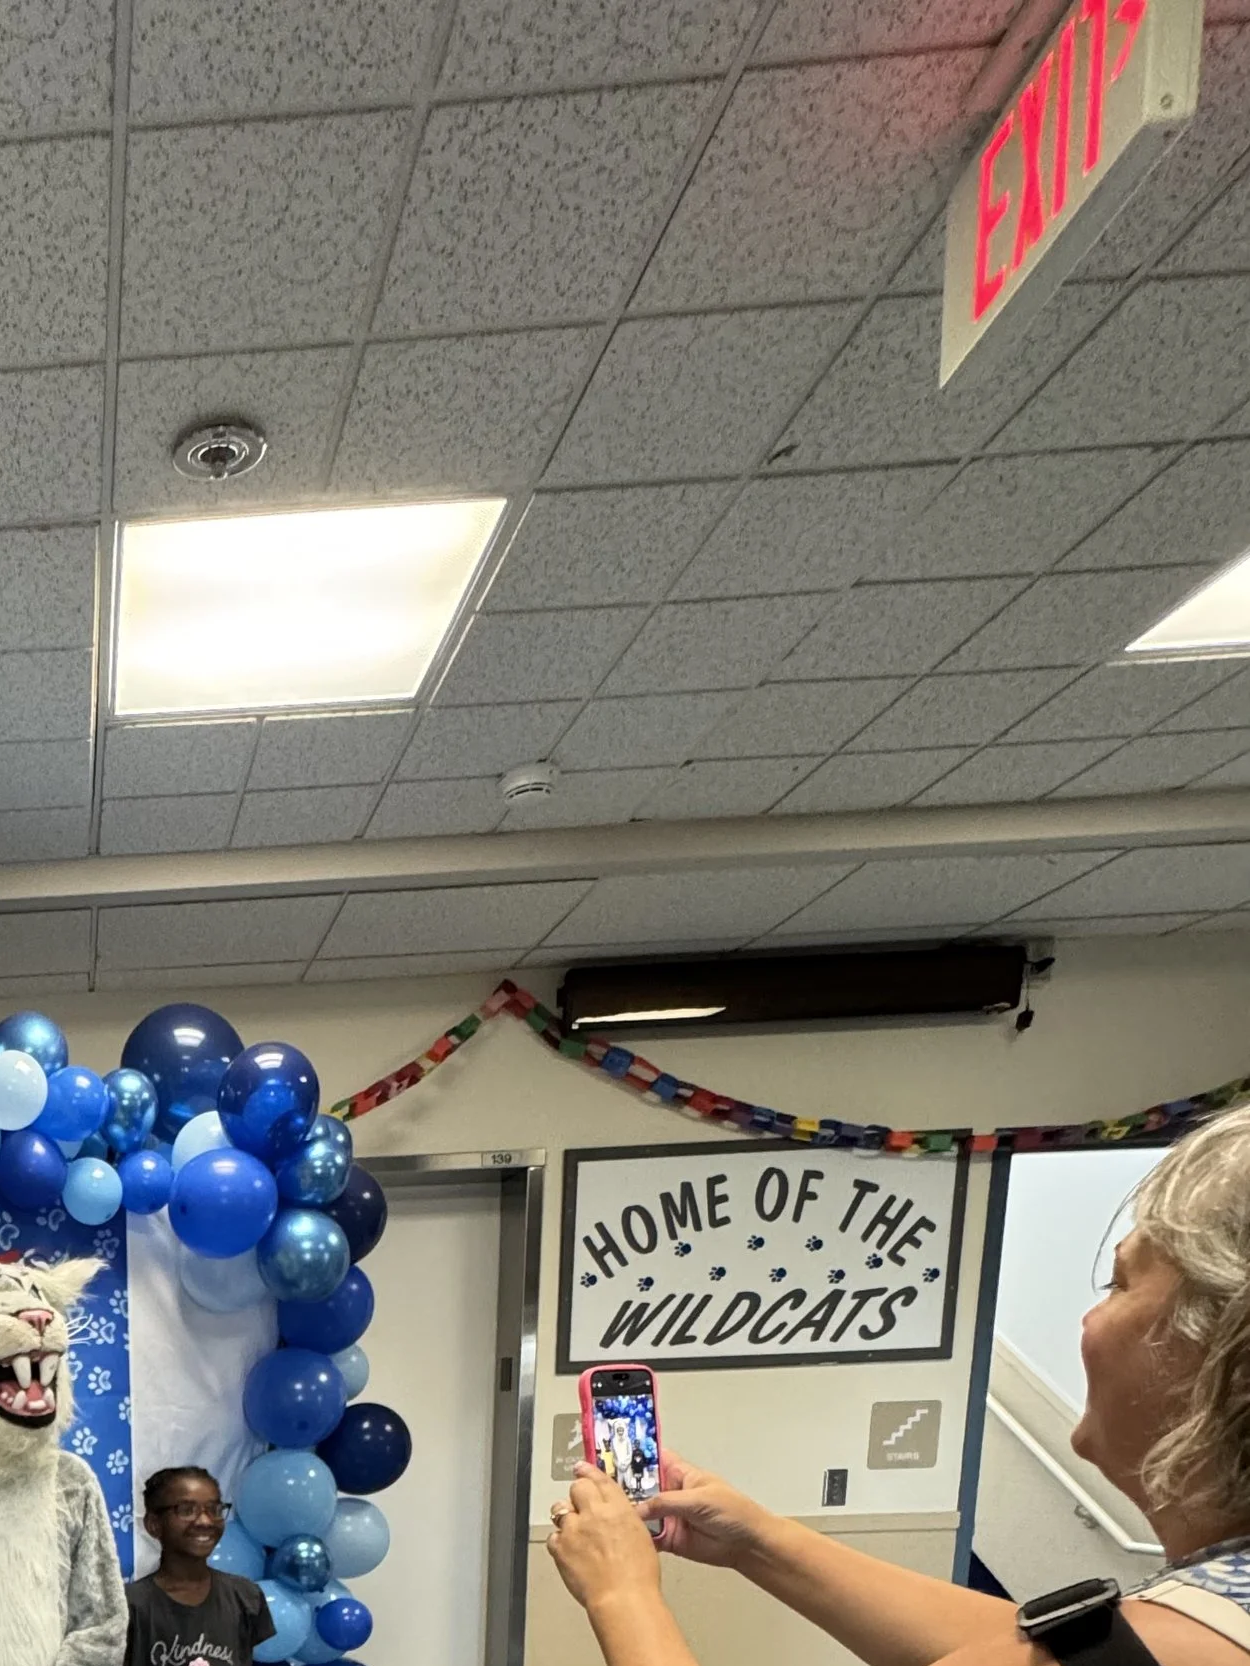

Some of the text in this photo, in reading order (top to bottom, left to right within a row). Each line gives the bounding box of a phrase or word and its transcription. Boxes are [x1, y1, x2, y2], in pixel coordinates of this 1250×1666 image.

[972, 0, 1108, 324] EXIT
[490, 1153, 512, 1165] 139
[582, 1166, 937, 1279] HOME OF THE
[598, 1285, 919, 1350] WILDCATS
